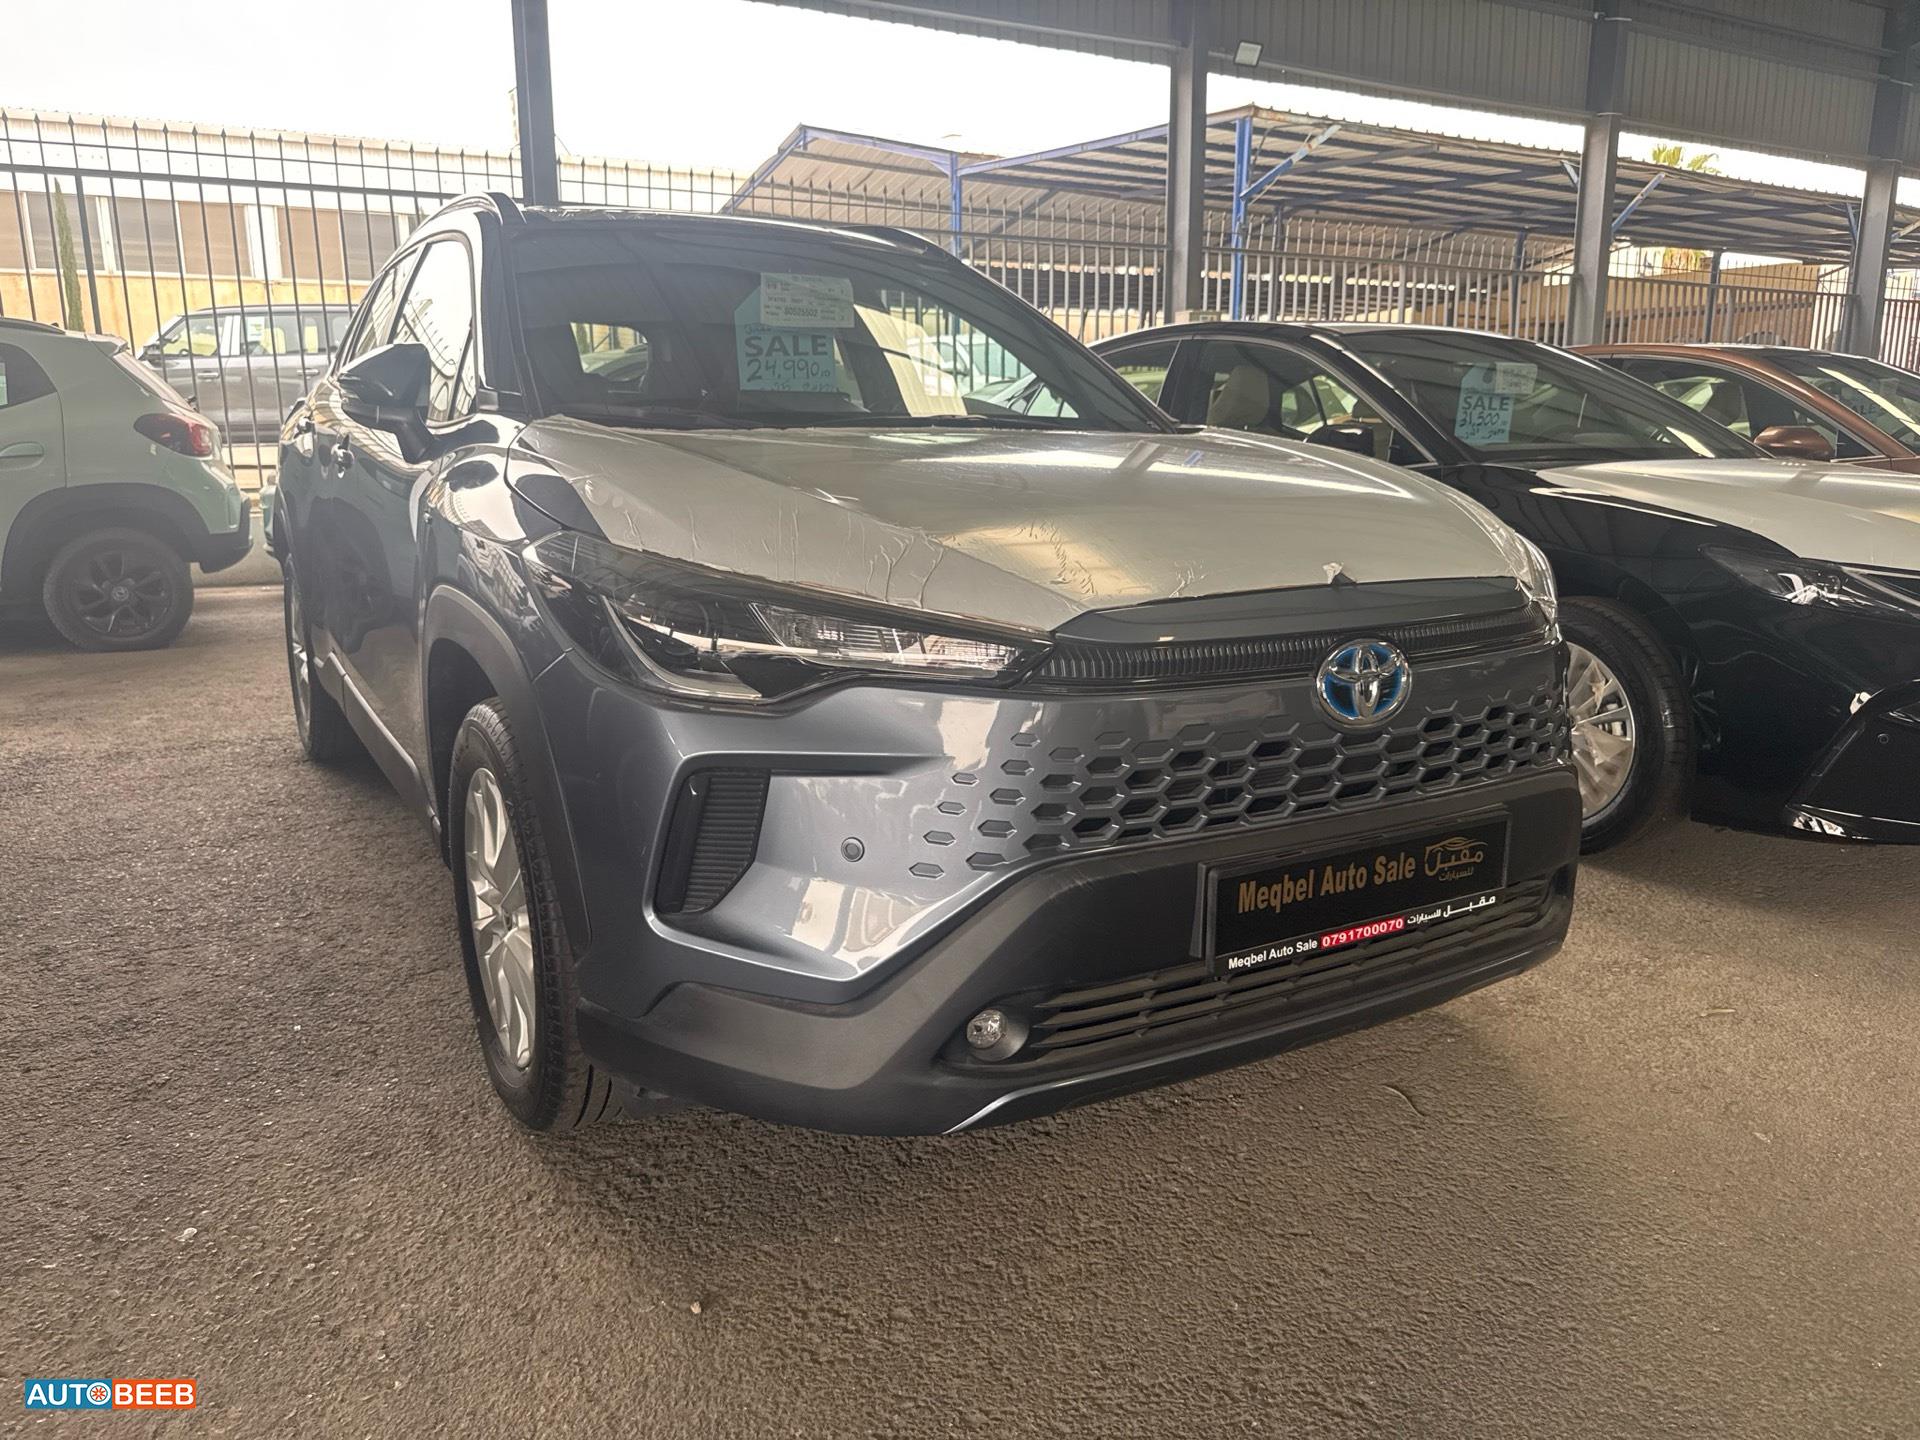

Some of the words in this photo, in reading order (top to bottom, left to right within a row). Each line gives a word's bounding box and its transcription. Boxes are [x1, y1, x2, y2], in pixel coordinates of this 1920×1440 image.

[744, 334, 829, 358] SALE
[1461, 395, 1510, 412] SALE
[1238, 868, 1315, 914] Meqbel
[1320, 862, 1368, 896] Auto
[1373, 851, 1416, 885] Sale
[1439, 866, 1474, 881] للسيارات
[1407, 908, 1442, 925] للسيارات
[1228, 950, 1267, 969] Meqbel
[1268, 945, 1294, 960] Auto
[1296, 939, 1318, 953] Sale
[1321, 917, 1404, 947] 0791700070
